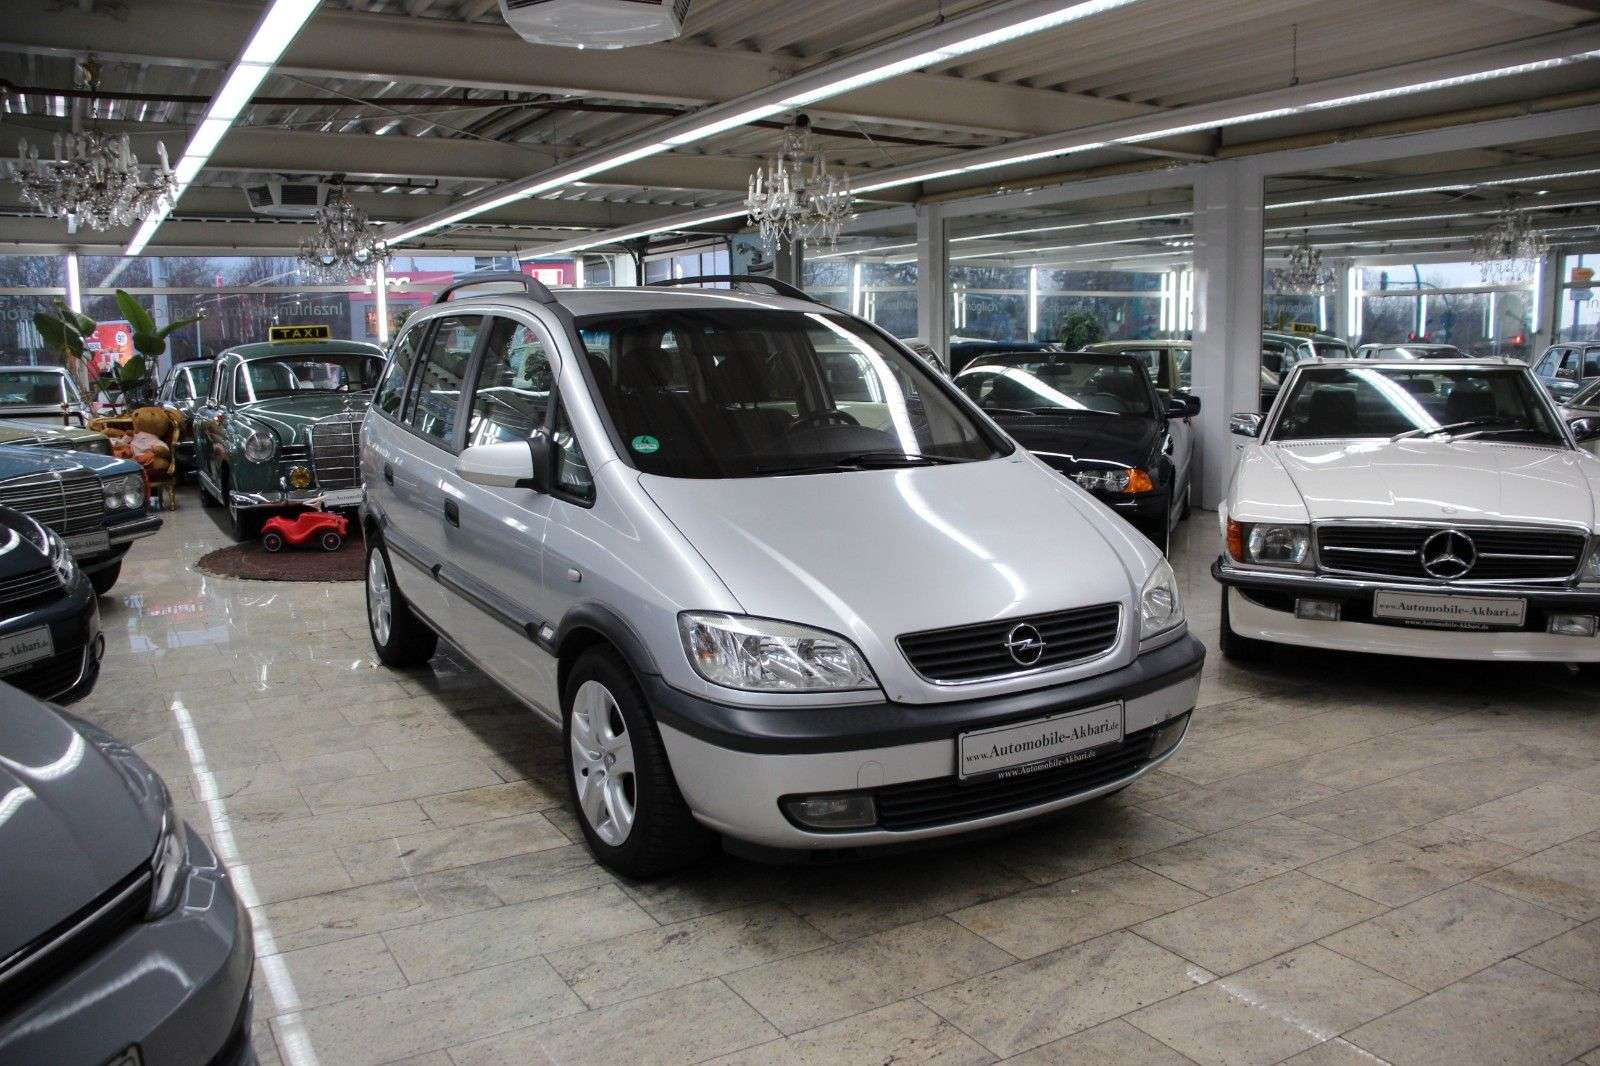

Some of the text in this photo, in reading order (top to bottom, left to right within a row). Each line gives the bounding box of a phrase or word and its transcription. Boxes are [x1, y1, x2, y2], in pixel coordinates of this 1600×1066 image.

[279, 328, 320, 339] TAXI
[1378, 600, 1520, 618] www.Automobile-Akbari.de
[965, 719, 1120, 763] www.Automobile-Akbari.de
